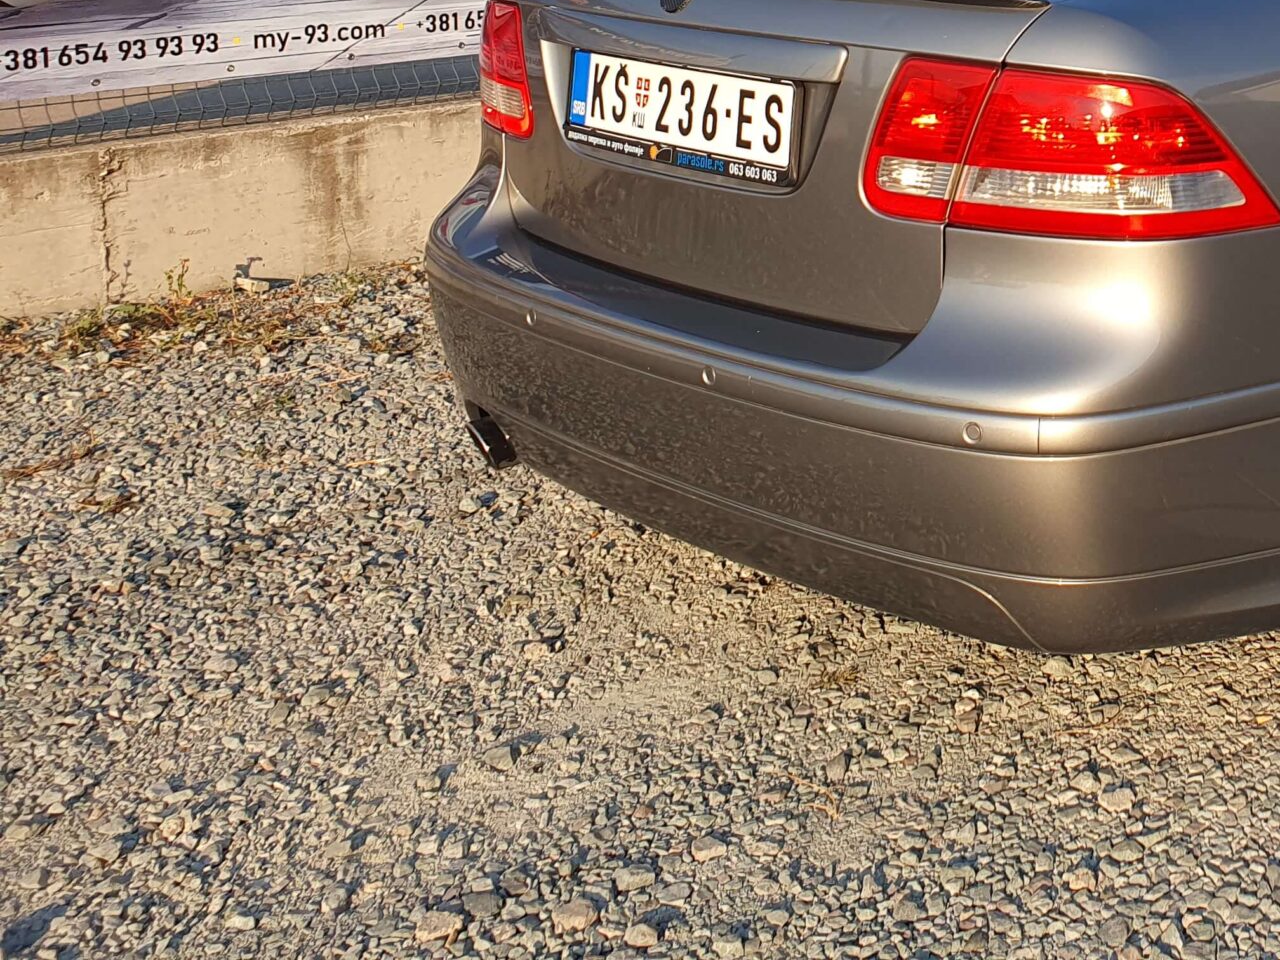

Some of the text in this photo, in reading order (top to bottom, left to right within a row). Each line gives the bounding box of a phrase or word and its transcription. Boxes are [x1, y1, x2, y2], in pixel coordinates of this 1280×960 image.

[0, 47, 49, 71] 381
[58, 42, 108, 66] 654
[118, 40, 146, 61] 93
[156, 35, 183, 57] 93
[192, 32, 220, 54] 93
[254, 23, 386, 52] my-93.com
[416, 12, 459, 33] +381
[572, 99, 586, 116] SRB
[590, 62, 630, 123] KŠ
[677, 152, 777, 183] parasole.rs 063 603 063
